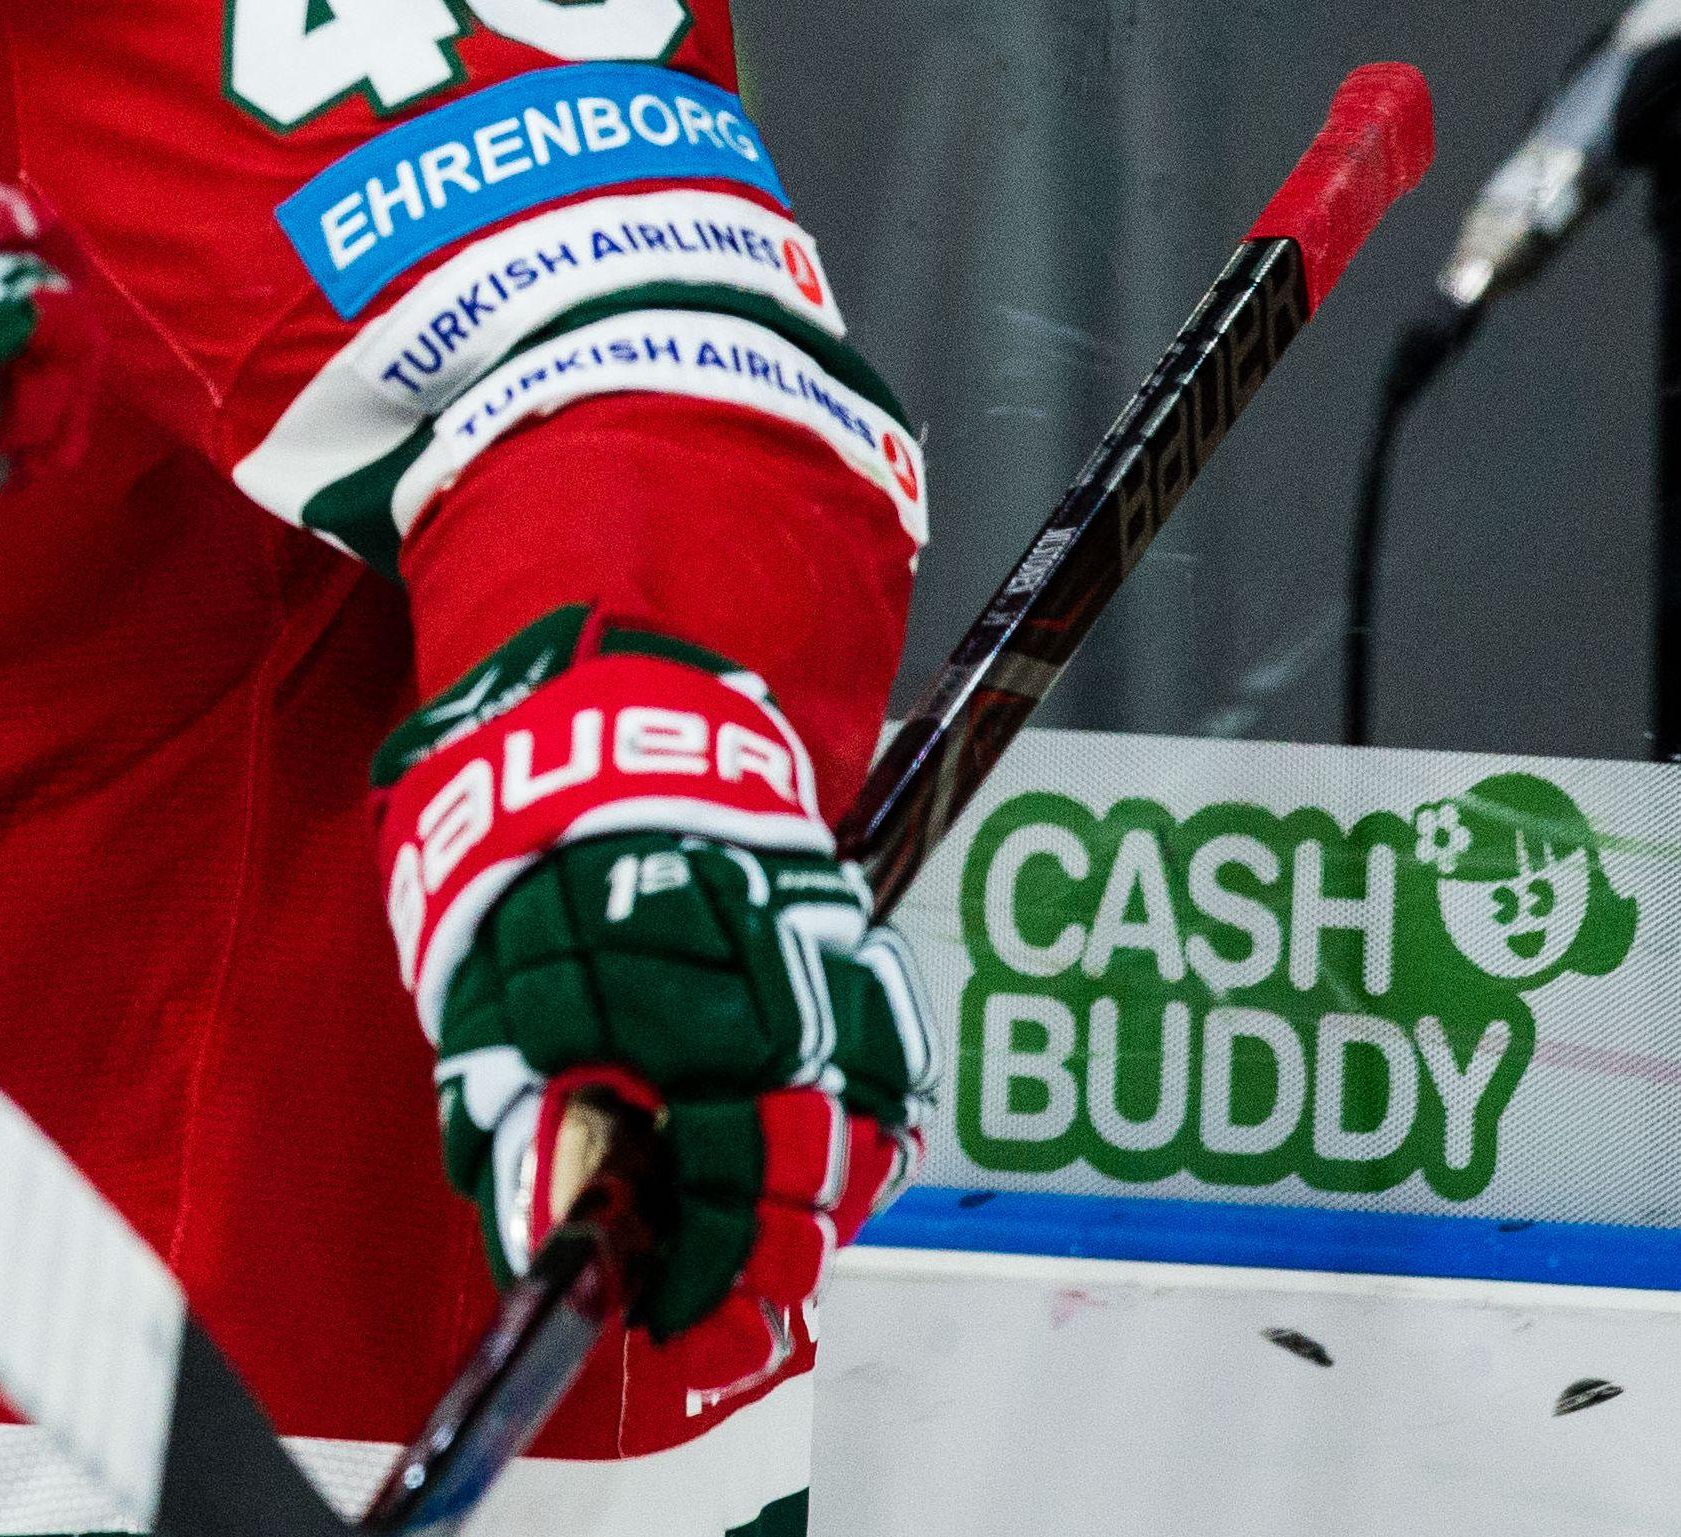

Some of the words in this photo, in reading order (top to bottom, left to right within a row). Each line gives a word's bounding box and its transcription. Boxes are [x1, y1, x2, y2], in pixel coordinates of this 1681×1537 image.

[319, 92, 761, 270] EHRENBORG
[380, 242, 579, 398] TURKISH
[591, 218, 784, 271] AIRLINES
[456, 334, 683, 441] TURKISH
[693, 340, 879, 450] AIRLINES
[983, 821, 1398, 996] CASH
[980, 992, 1512, 1170] BUDDY
